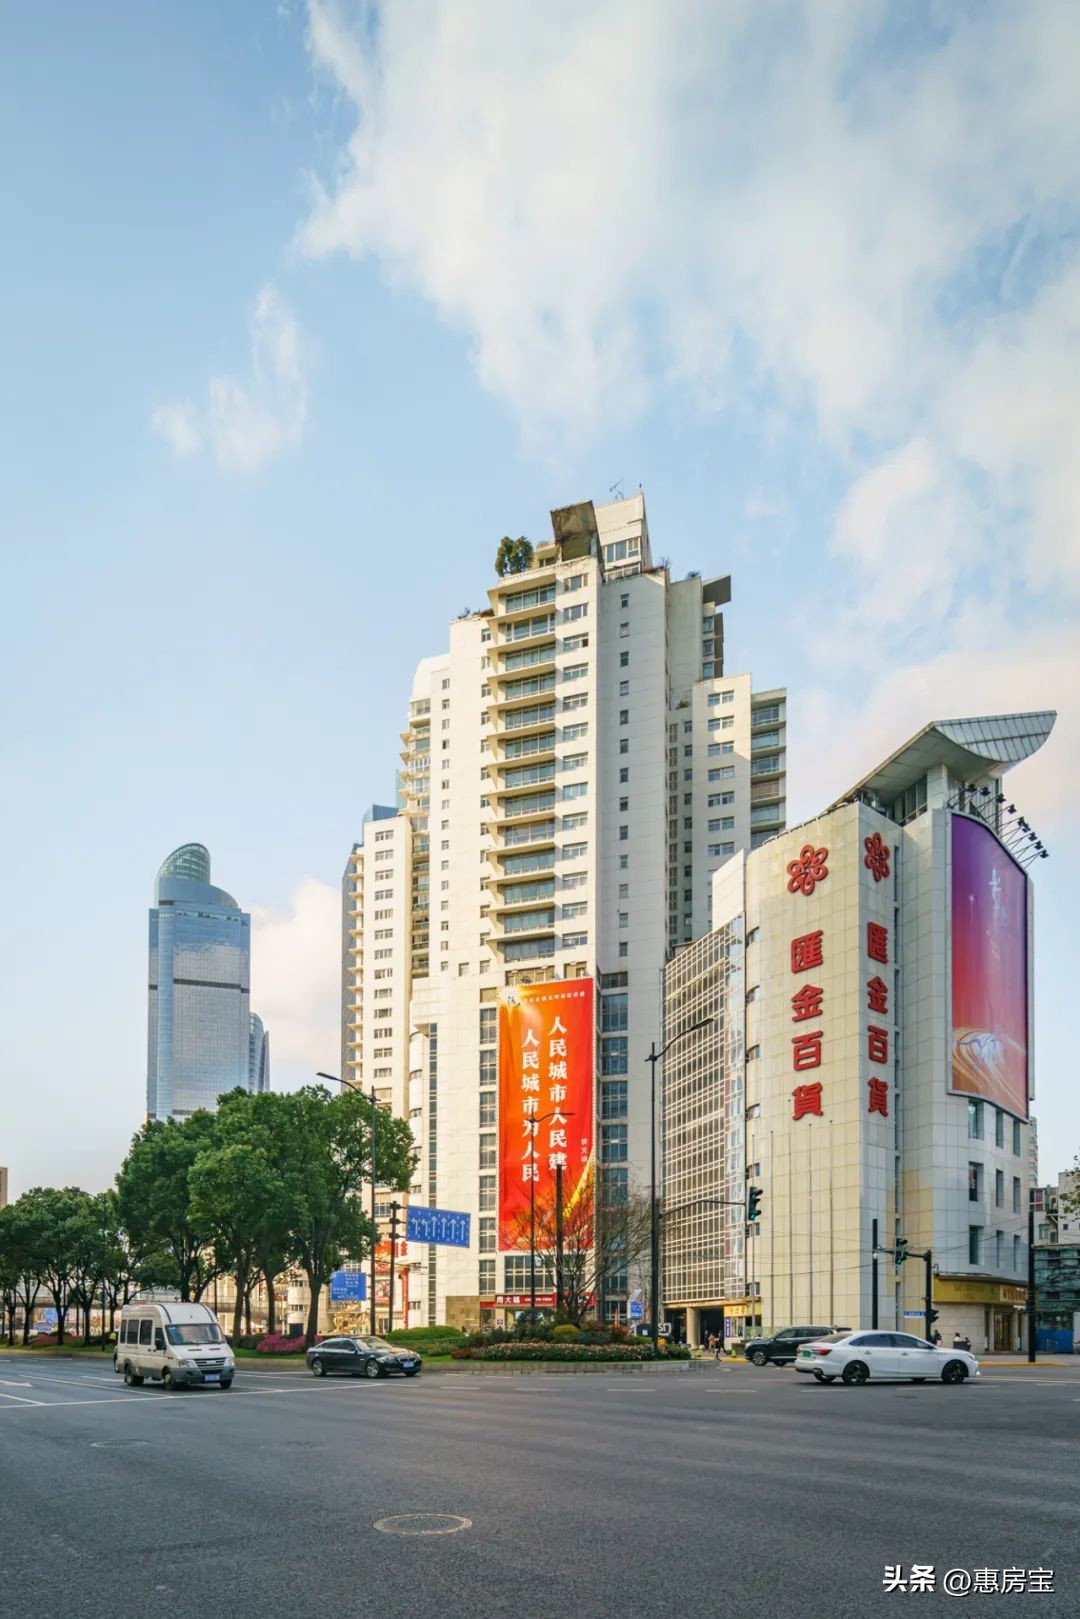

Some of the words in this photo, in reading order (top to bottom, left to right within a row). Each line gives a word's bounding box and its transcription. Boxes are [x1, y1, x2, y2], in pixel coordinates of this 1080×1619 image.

[521, 1028, 541, 1183] 人民城市为人民
[548, 1015, 568, 1172] 人民城市人民建
[791, 929, 823, 1121] 匯金百貨
[867, 921, 889, 1118] 匯金百貨
